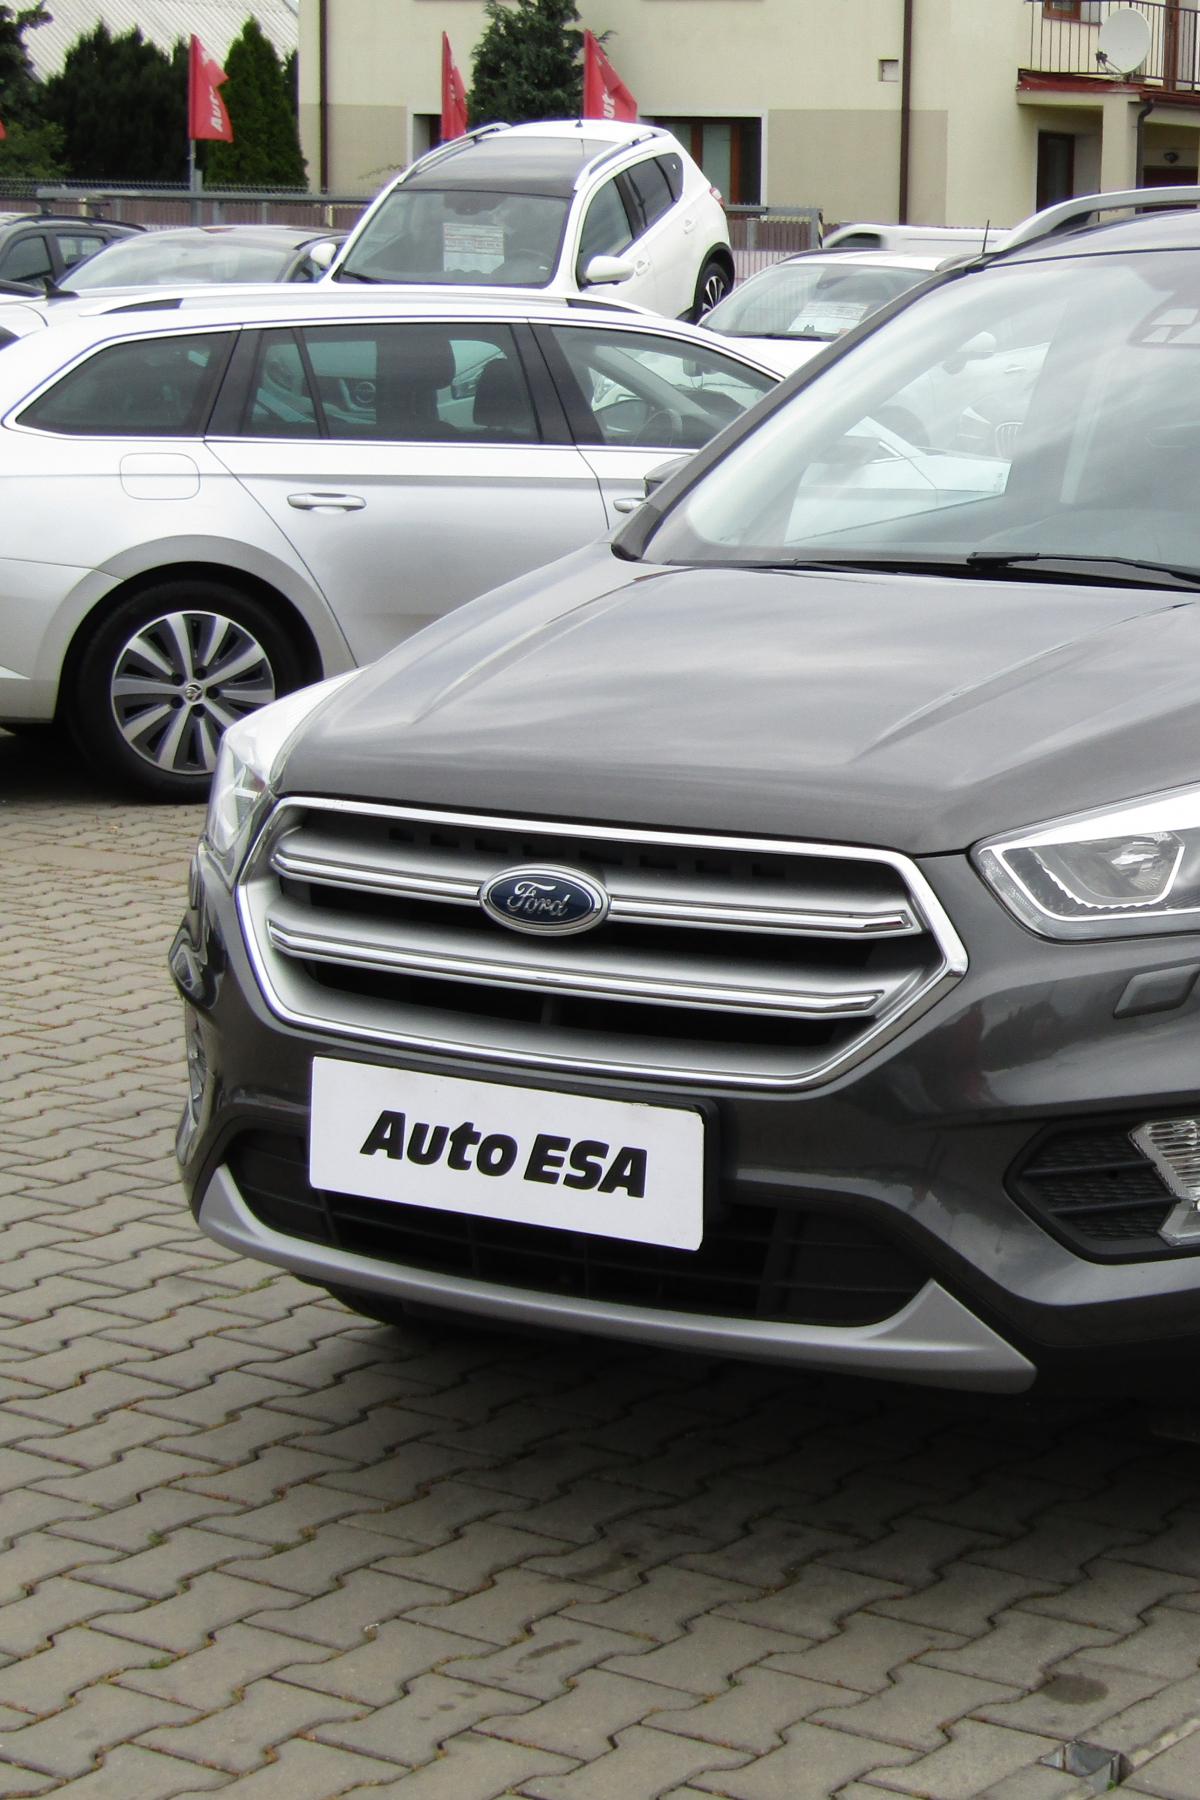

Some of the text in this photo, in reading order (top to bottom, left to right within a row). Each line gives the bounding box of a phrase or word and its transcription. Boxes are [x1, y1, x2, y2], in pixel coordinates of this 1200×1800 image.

[507, 881, 571, 917] Ford
[360, 1110, 648, 1199] Auto ESA
